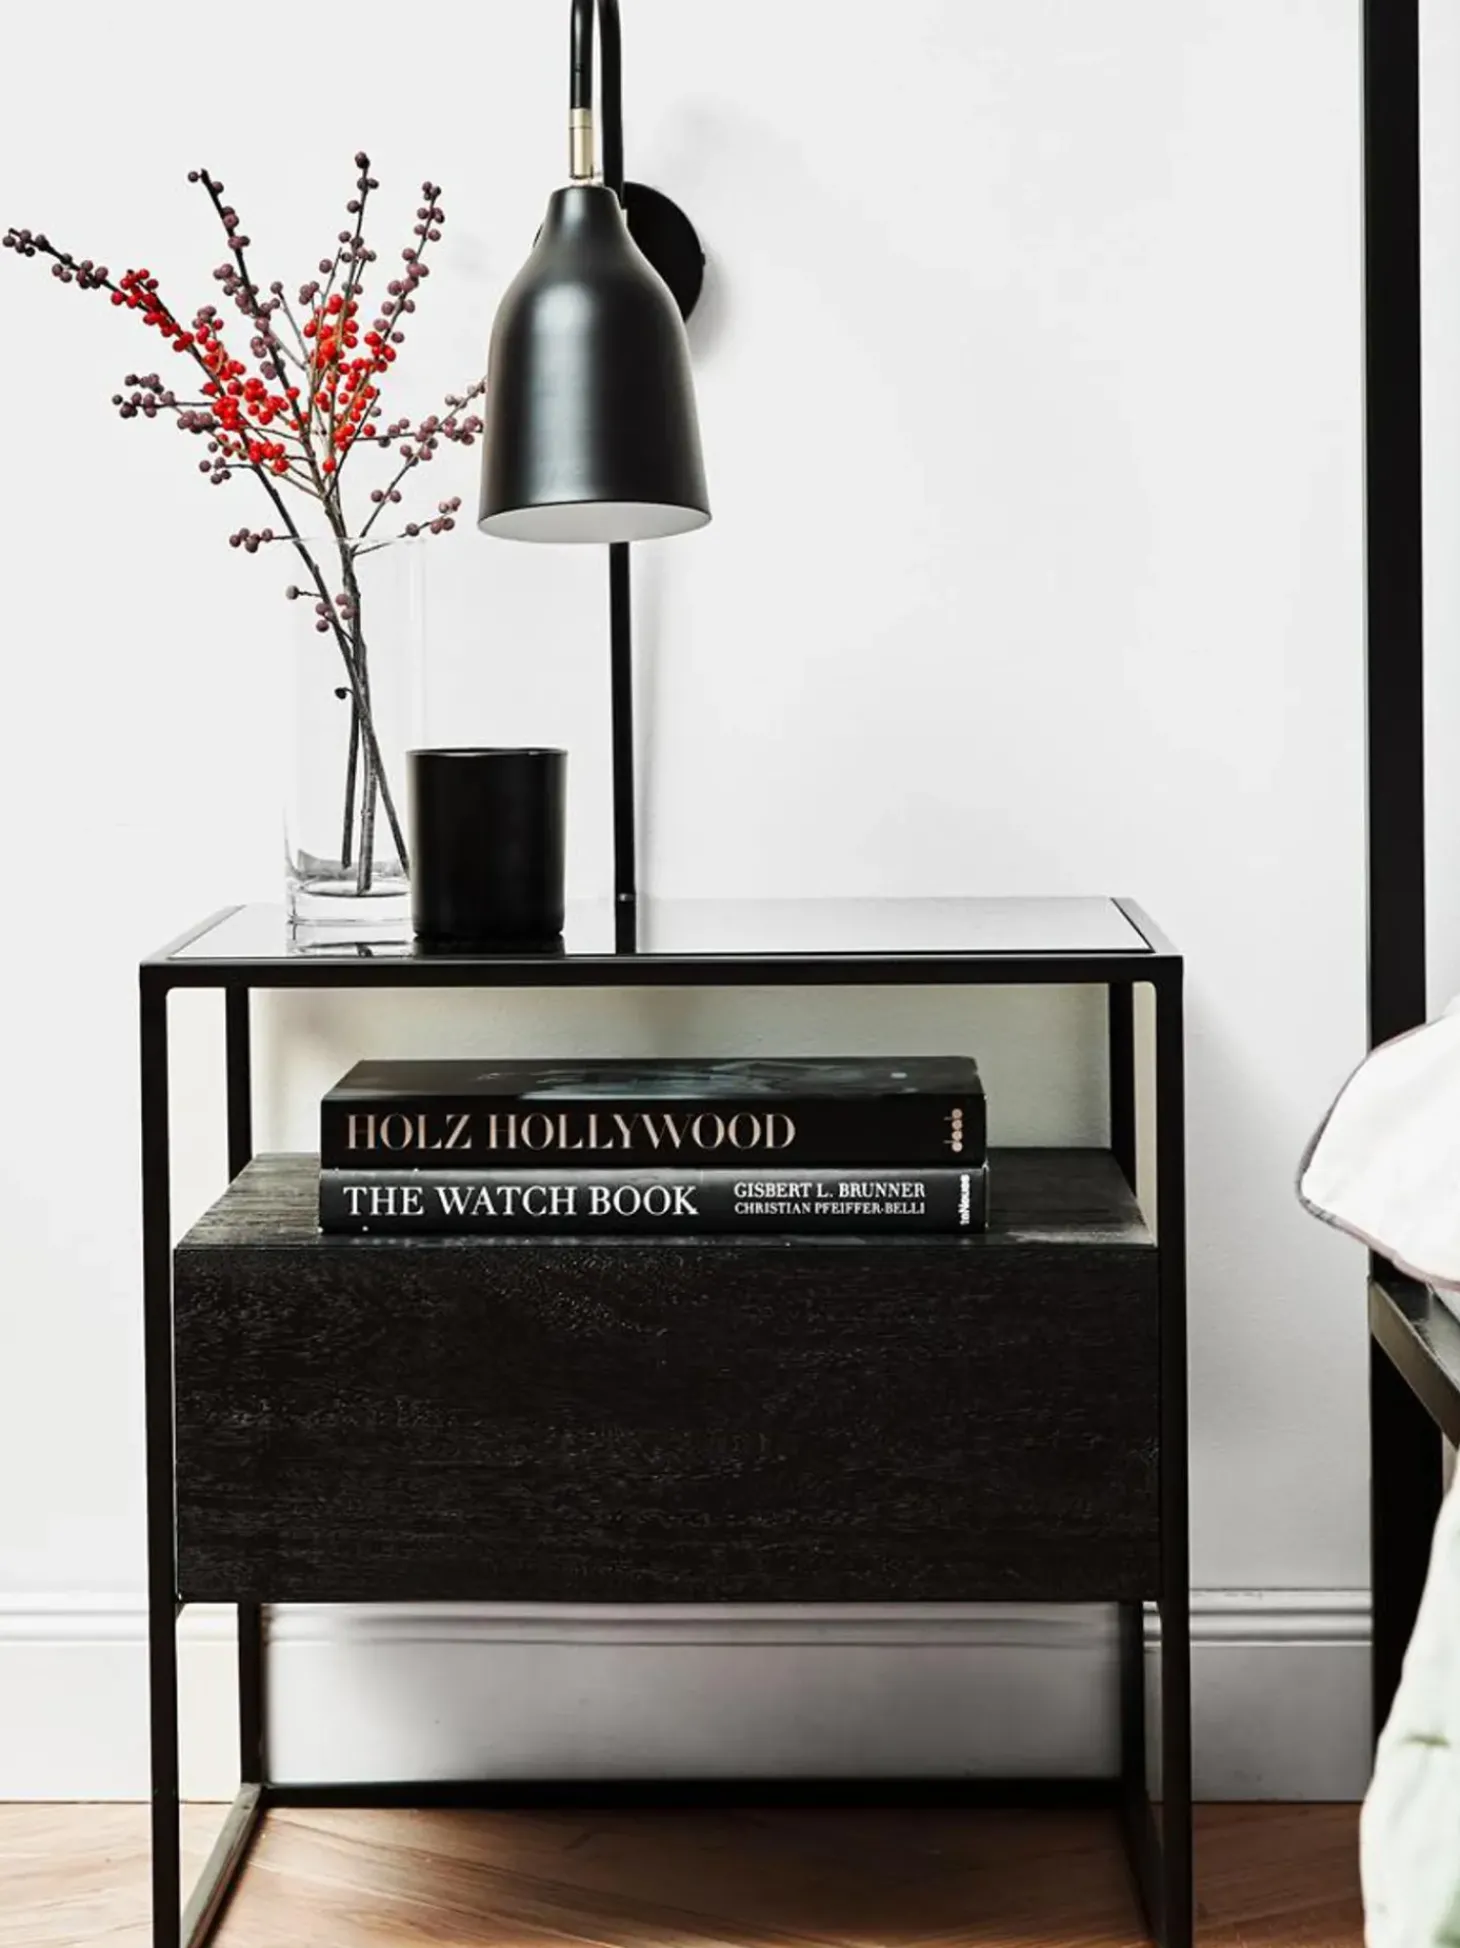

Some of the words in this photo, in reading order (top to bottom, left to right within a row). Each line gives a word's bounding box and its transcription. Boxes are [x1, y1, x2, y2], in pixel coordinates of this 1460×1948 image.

[348, 1113, 472, 1149] HOLZ
[489, 1113, 796, 1149] HOLLYWOOD
[343, 1186, 423, 1215] THE
[434, 1186, 577, 1216] WATCH
[588, 1186, 699, 1216] BOOK
[734, 1182, 812, 1198] GISBERT
[816, 1182, 834, 1198] L.
[838, 1182, 926, 1198] BRUNNER
[734, 1202, 811, 1215] CHRISTIAN
